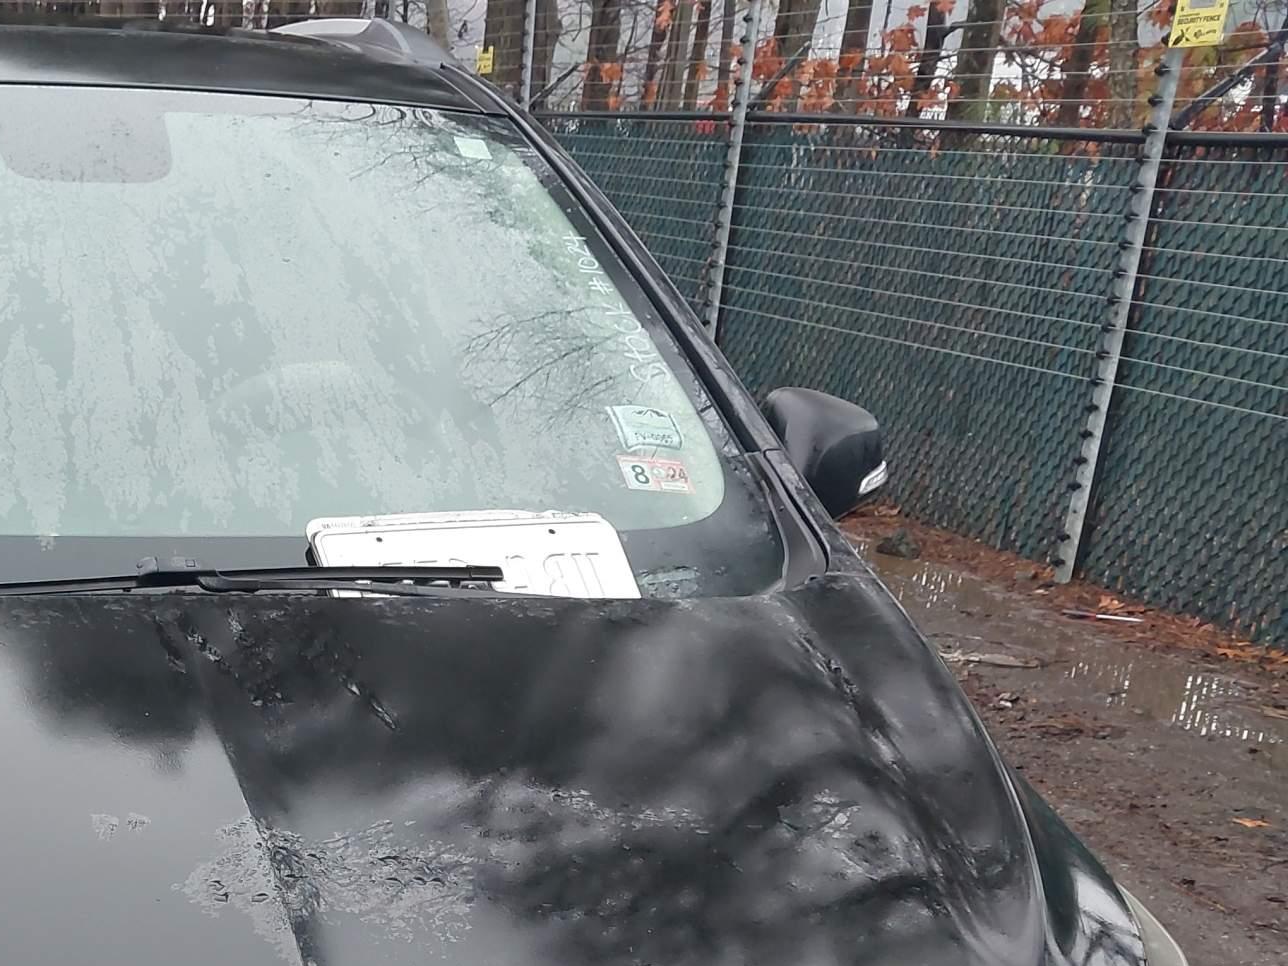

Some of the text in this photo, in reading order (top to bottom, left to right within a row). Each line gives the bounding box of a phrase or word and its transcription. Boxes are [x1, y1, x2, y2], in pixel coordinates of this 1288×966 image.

[1177, 15, 1221, 25] SECURITY FENCE
[631, 464, 650, 484] 8
